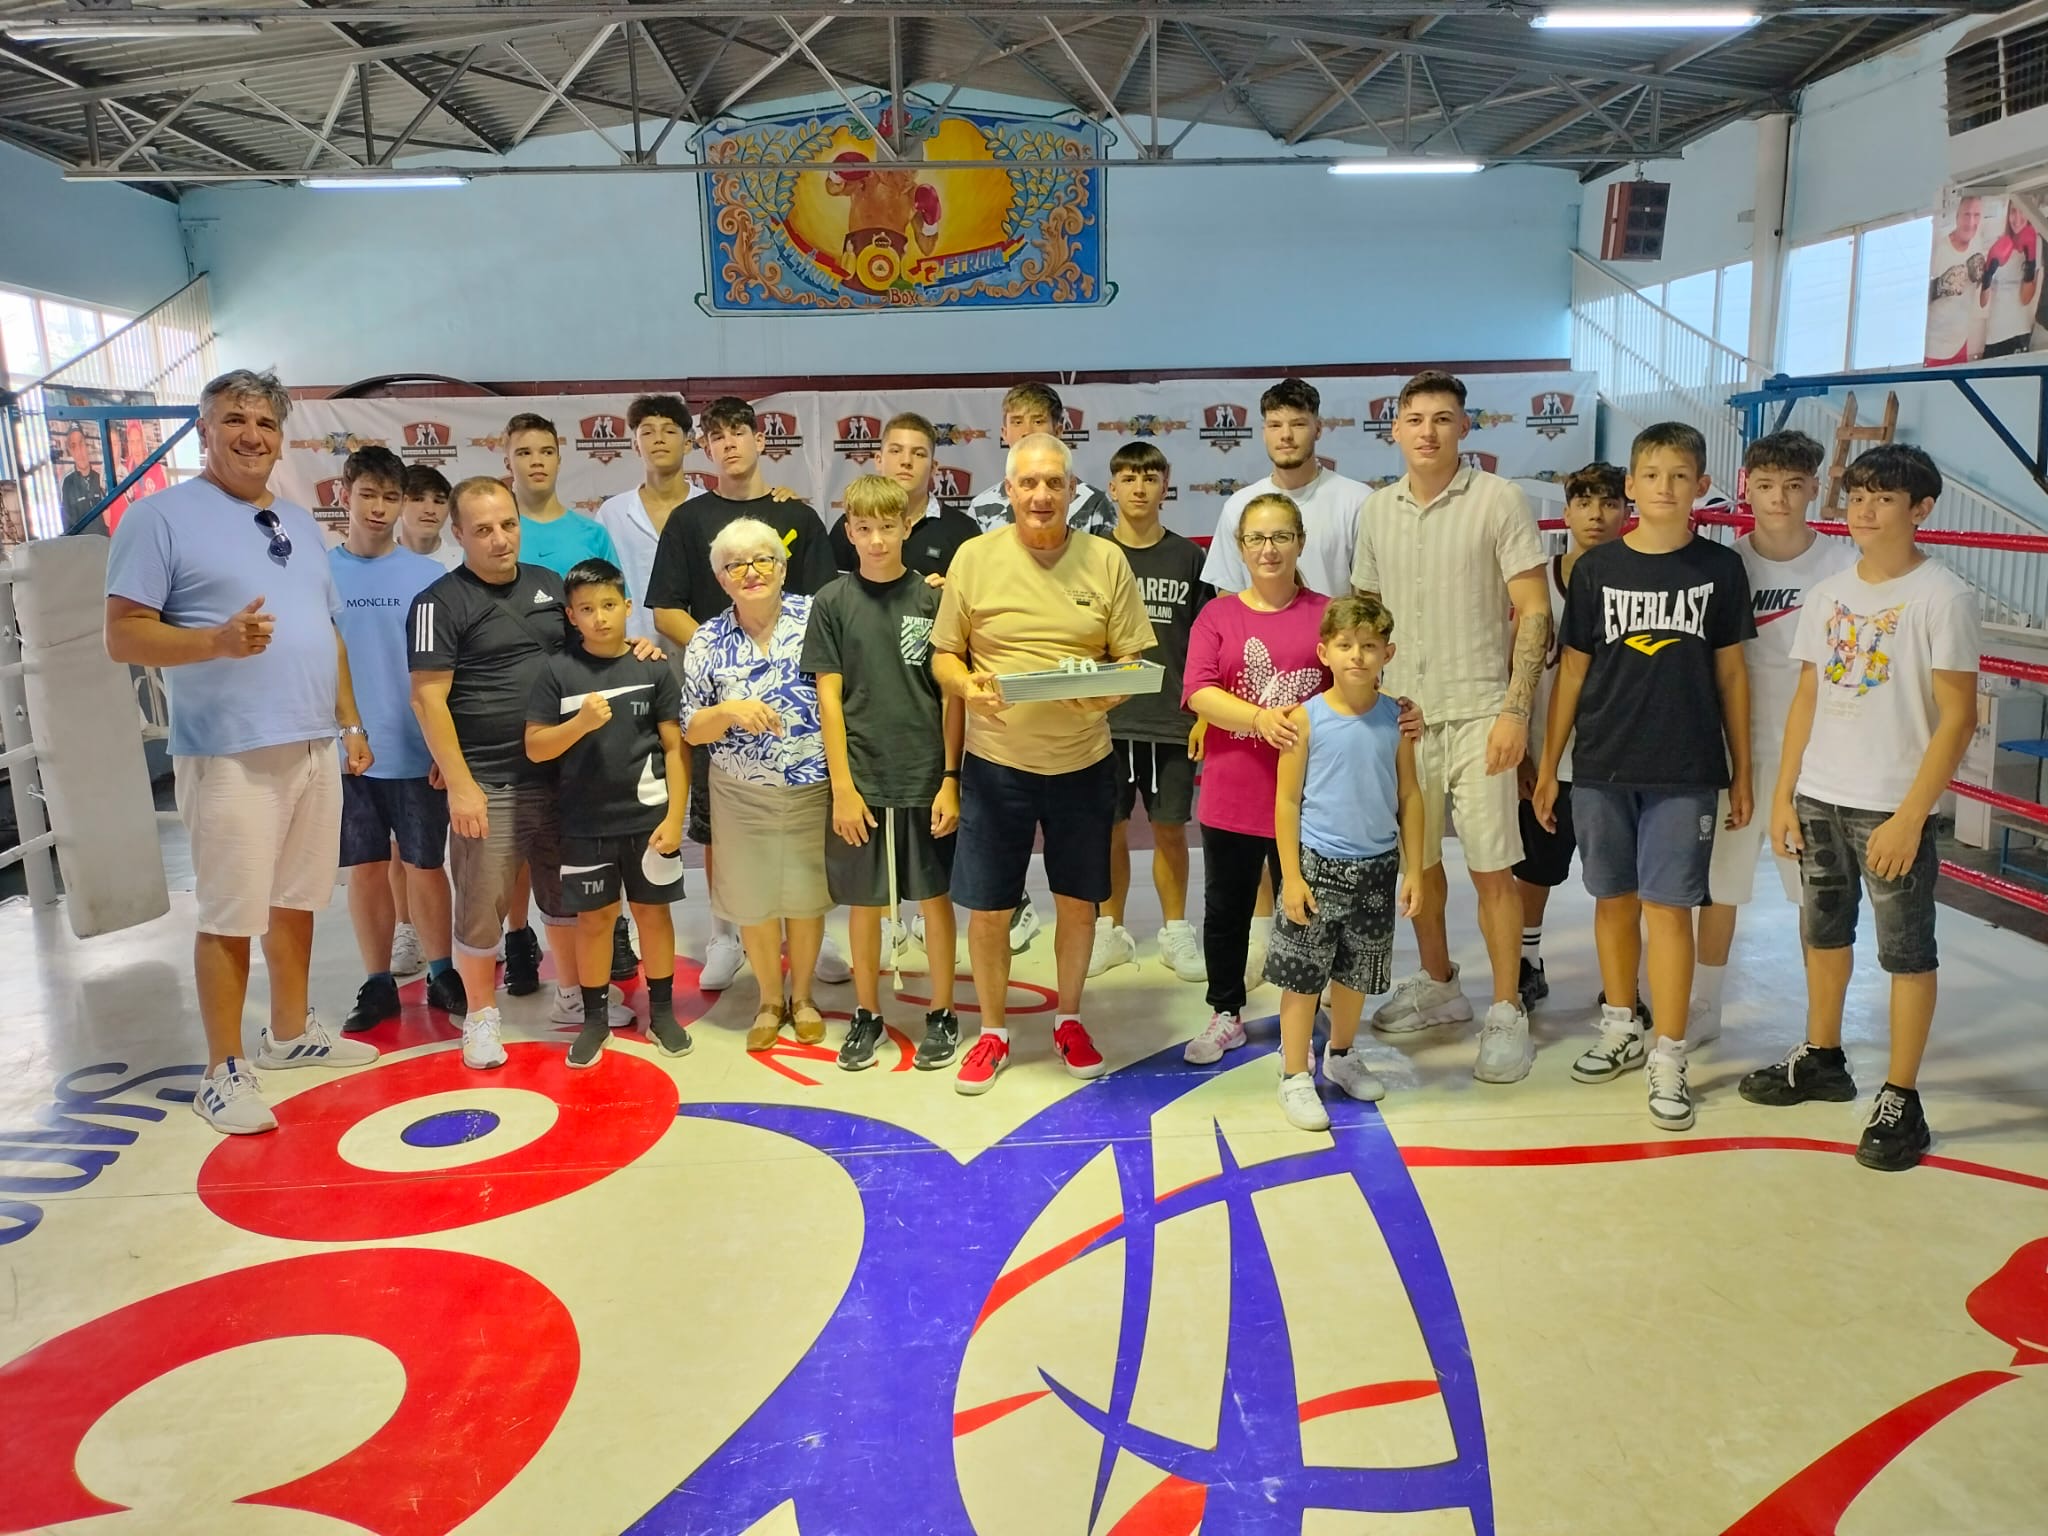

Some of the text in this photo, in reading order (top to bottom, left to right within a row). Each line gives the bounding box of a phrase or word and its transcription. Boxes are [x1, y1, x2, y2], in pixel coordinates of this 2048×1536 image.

[346, 598, 401, 608] MONCLER
[1752, 588, 1801, 611] NIKE
[1602, 581, 1714, 645] EVERLAST
[630, 701, 650, 716] TM
[582, 879, 605, 895] TM
